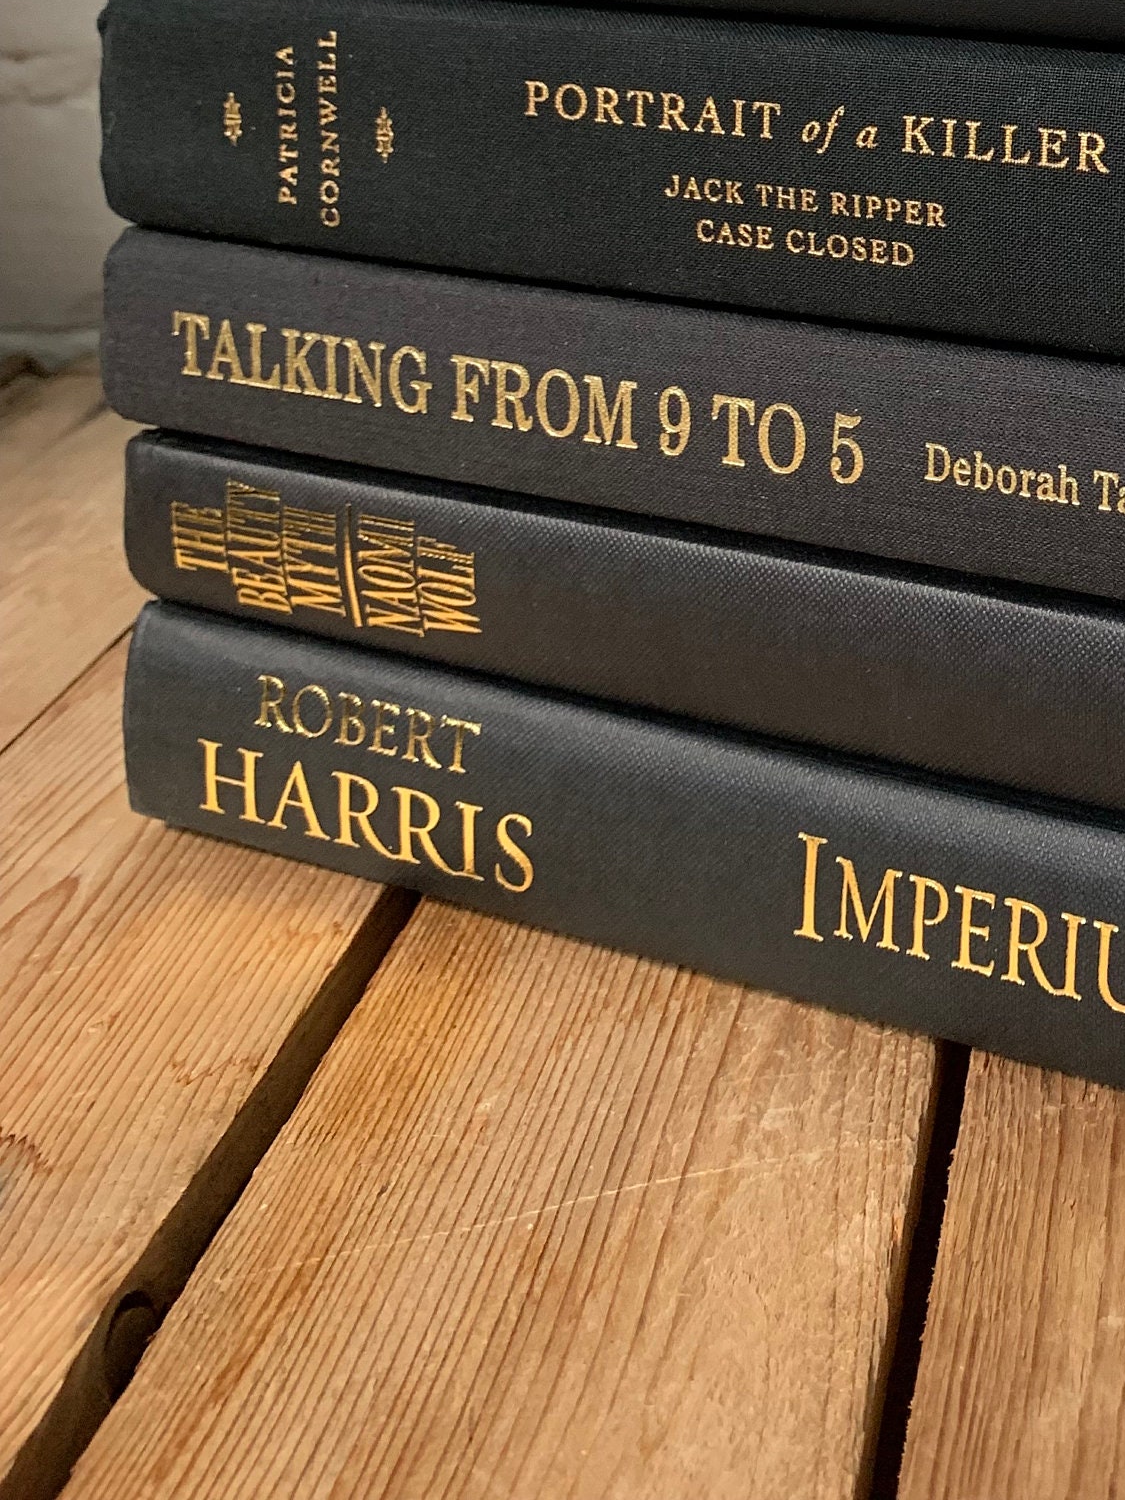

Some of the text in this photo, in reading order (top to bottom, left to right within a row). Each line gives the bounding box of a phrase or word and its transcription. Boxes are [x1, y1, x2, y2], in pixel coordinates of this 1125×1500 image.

[275, 46, 299, 205] PATRICIA
[317, 30, 340, 228] CORNWELL
[524, 80, 1109, 174] PORTRAIT of a KILLER
[663, 174, 945, 228] JACK THE RIPPER
[695, 218, 915, 268] CASE CLOSED
[171, 309, 865, 485] TALKING FROM 9 TO 5
[923, 441, 1081, 506] Deborah
[171, 500, 229, 573] THE
[226, 478, 294, 615] BEAUTY
[282, 505, 346, 617] MYTH
[355, 513, 425, 638] NAOMI
[416, 535, 482, 635] WOLF
[253, 673, 483, 774] ROBERT
[197, 738, 535, 893] HARRIS
